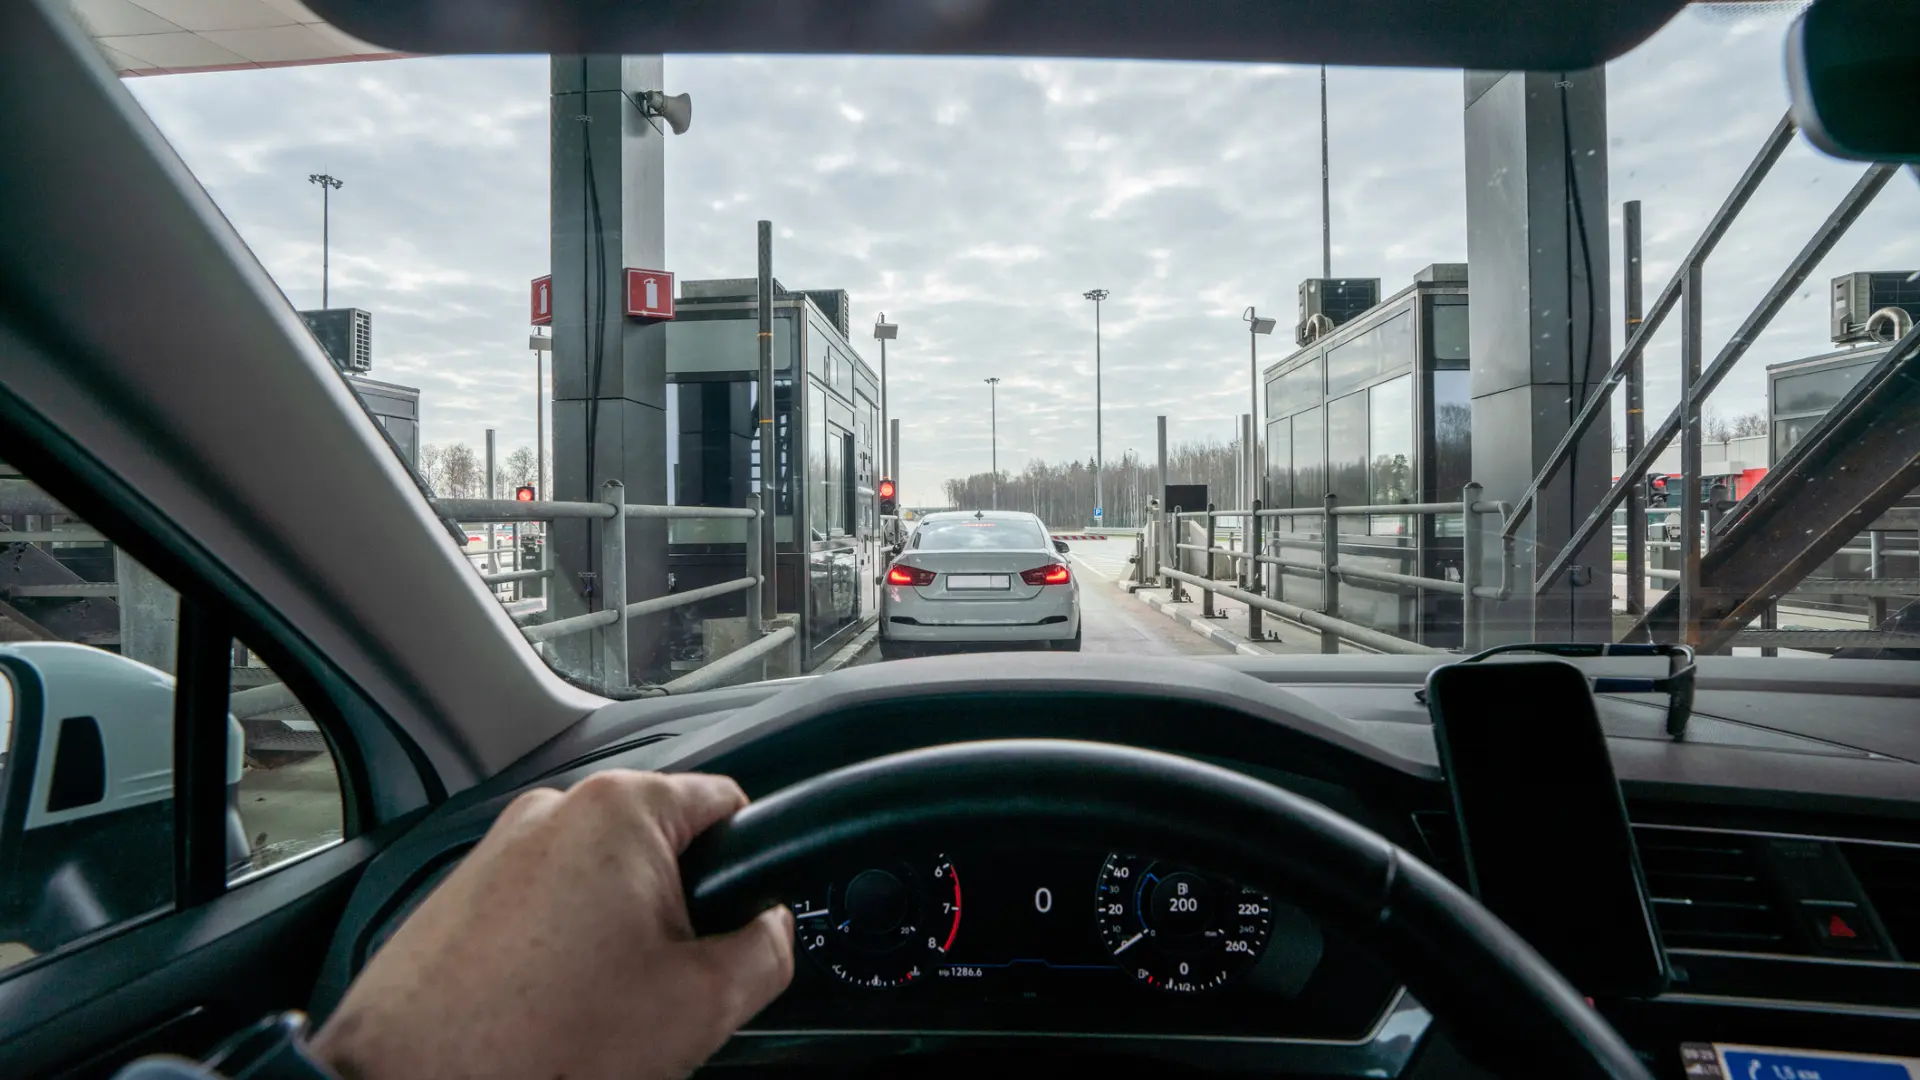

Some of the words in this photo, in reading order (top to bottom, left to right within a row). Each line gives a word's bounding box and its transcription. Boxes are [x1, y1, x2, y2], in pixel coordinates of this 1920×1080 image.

[934, 866, 943, 877] 6
[1113, 867, 1129, 878] 40
[1109, 885, 1120, 894] 30
[804, 900, 810, 911] 1
[1035, 887, 1052, 913] 0
[1169, 898, 1198, 912] 200
[942, 902, 950, 914] 7
[1108, 904, 1123, 915] 20
[1238, 904, 1260, 915] 220
[843, 925, 850, 934] 0
[900, 926, 910, 935] 20
[1150, 929, 1156, 937] 0
[815, 935, 825, 946] 0
[928, 937, 937, 949] 8
[1225, 940, 1247, 952] 260
[951, 967, 982, 977] 1286.6
[1179, 962, 1189, 975] 0
[1178, 982, 1191, 992] 1/2
